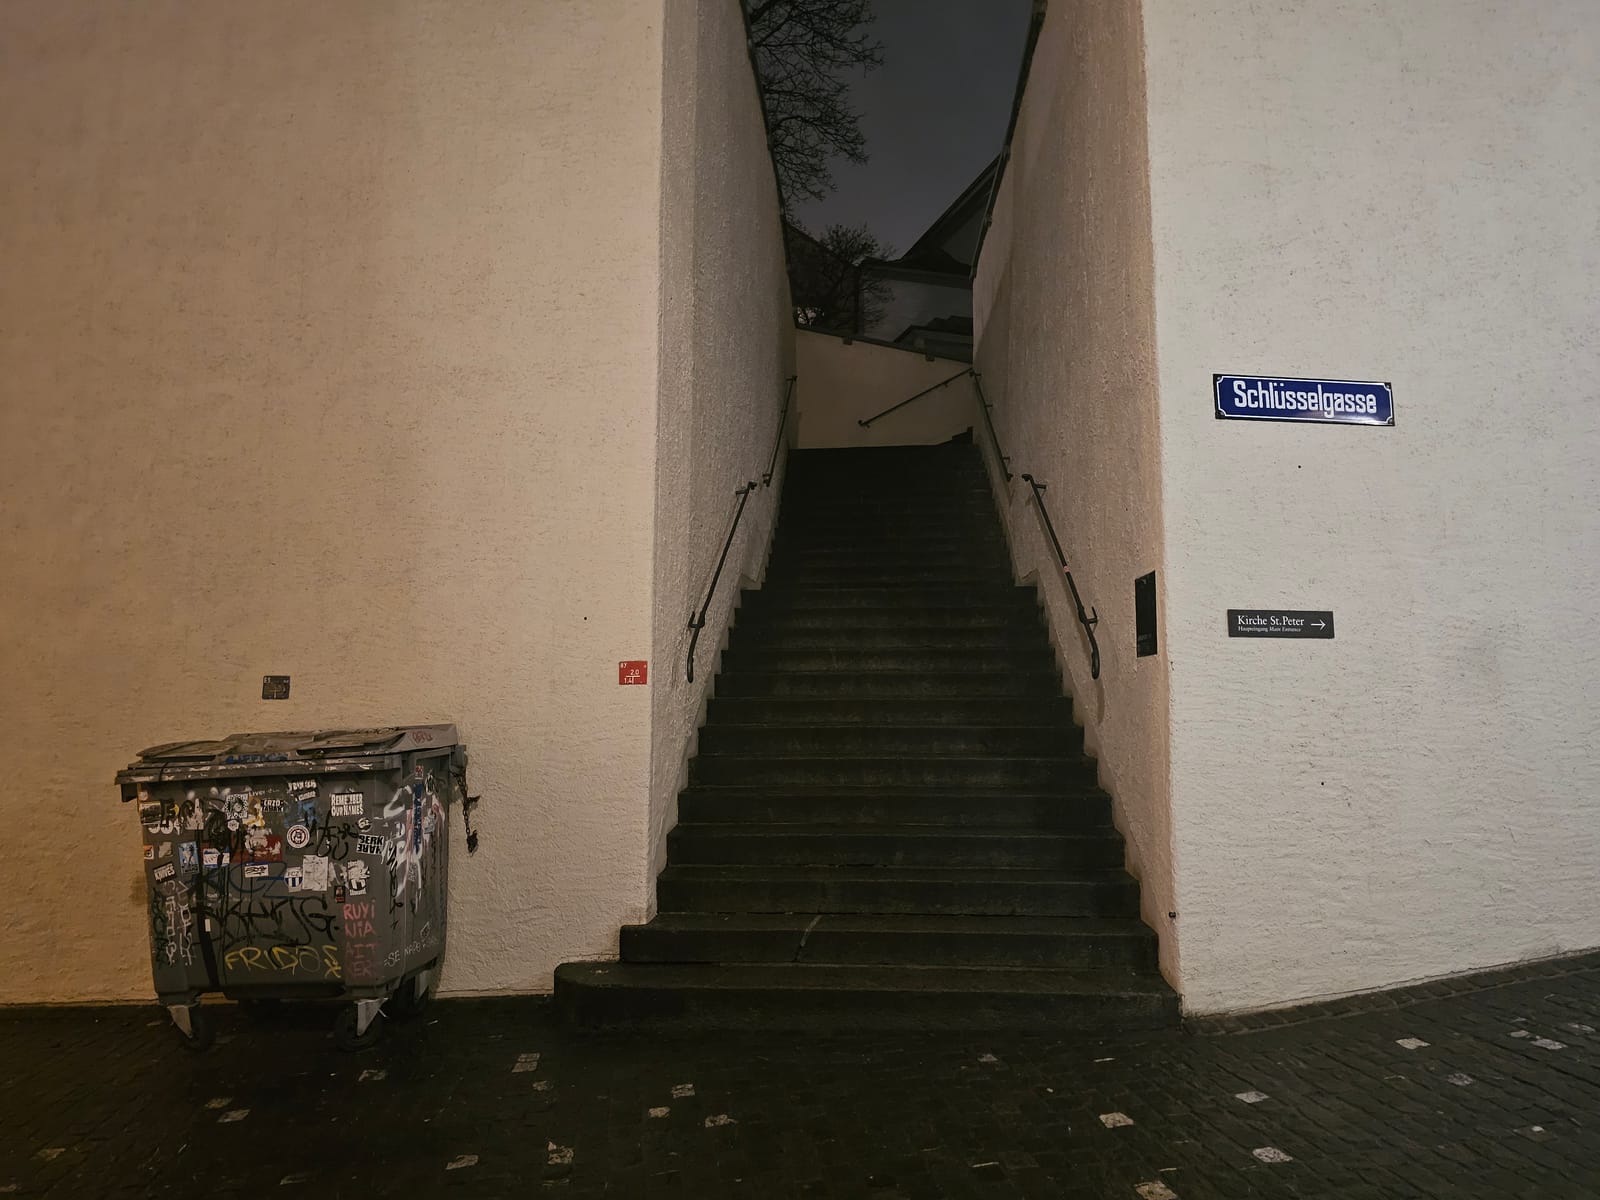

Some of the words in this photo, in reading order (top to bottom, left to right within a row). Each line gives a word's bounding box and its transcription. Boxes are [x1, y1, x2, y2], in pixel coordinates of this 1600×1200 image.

[1233, 380, 1377, 418] Schlüsselgasse
[1238, 615, 1268, 625] Kirche
[1282, 616, 1305, 626] Peter
